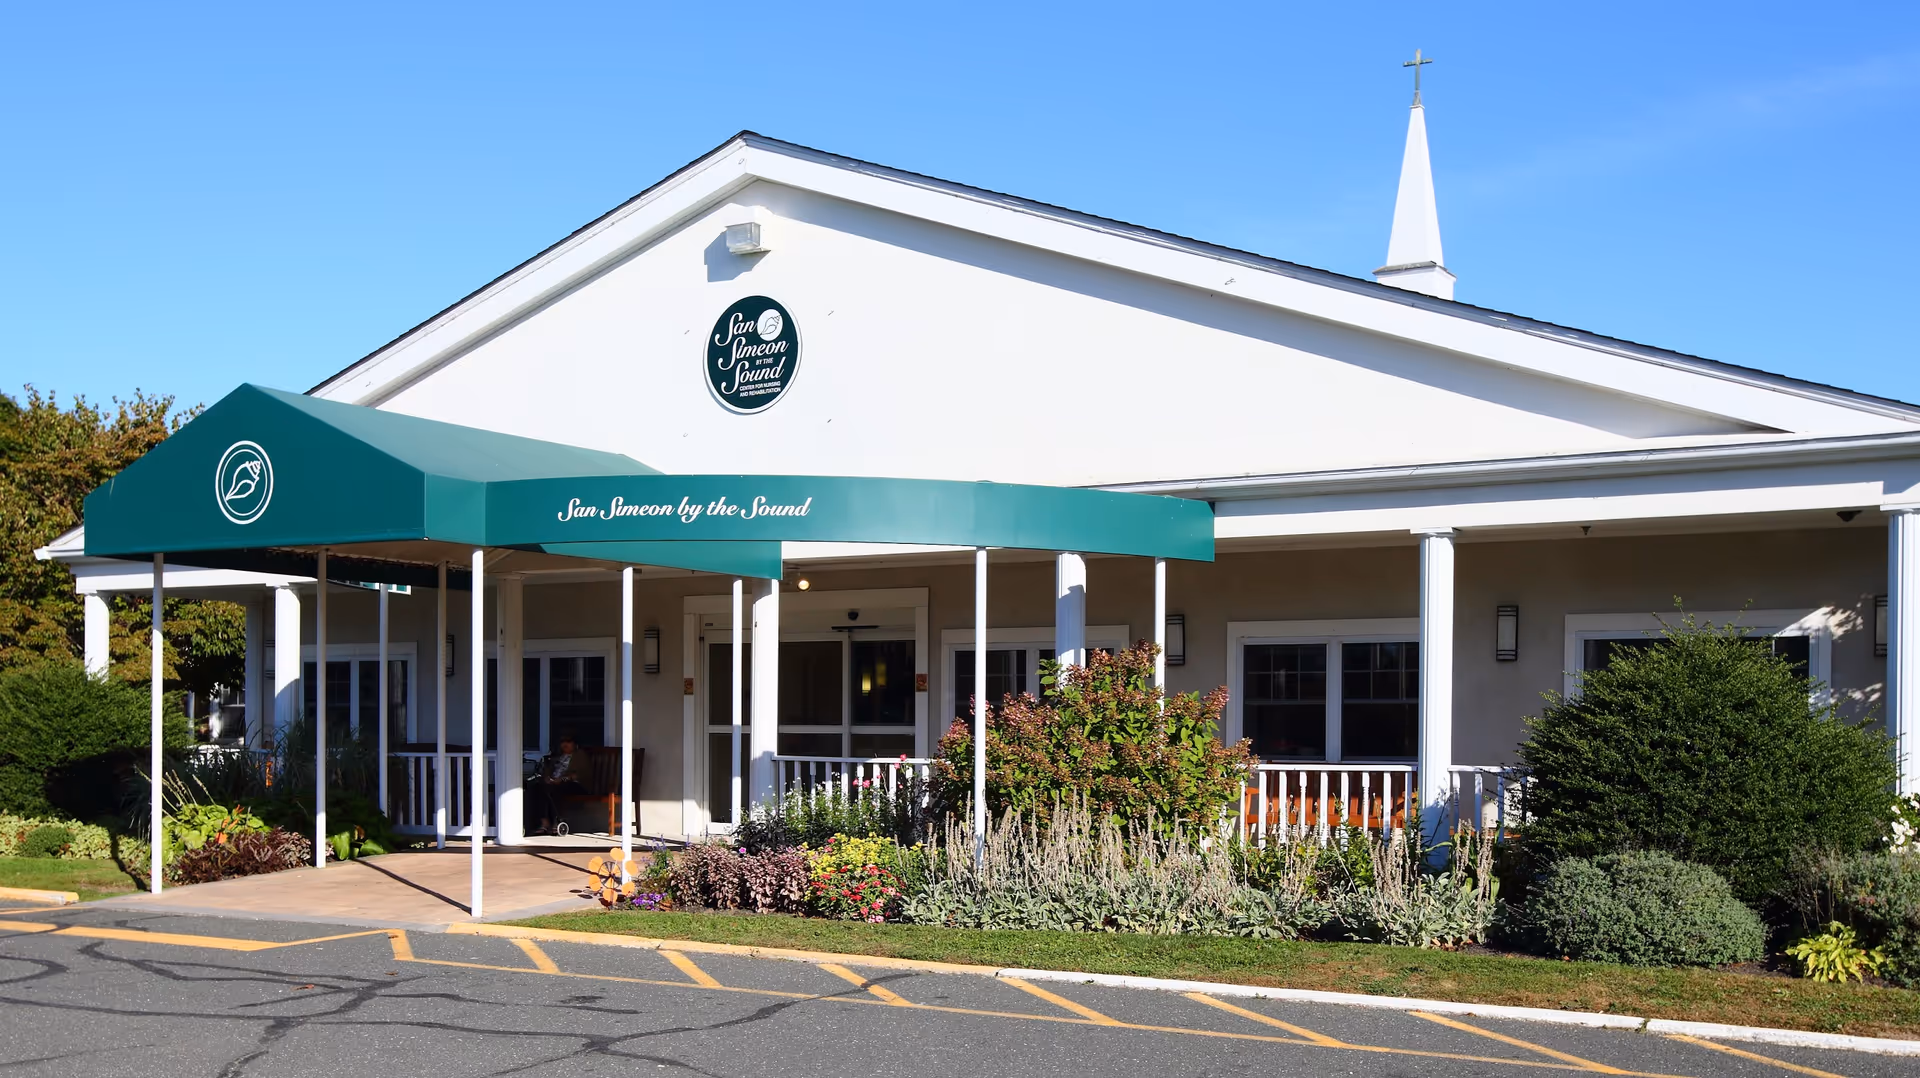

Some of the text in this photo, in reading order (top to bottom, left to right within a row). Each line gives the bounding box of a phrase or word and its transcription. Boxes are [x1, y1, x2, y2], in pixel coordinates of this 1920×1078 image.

[715, 312, 757, 346] San
[718, 337, 789, 370] Simeon
[721, 356, 786, 394] Sound
[557, 495, 812, 523] San Simeon by the Sound
